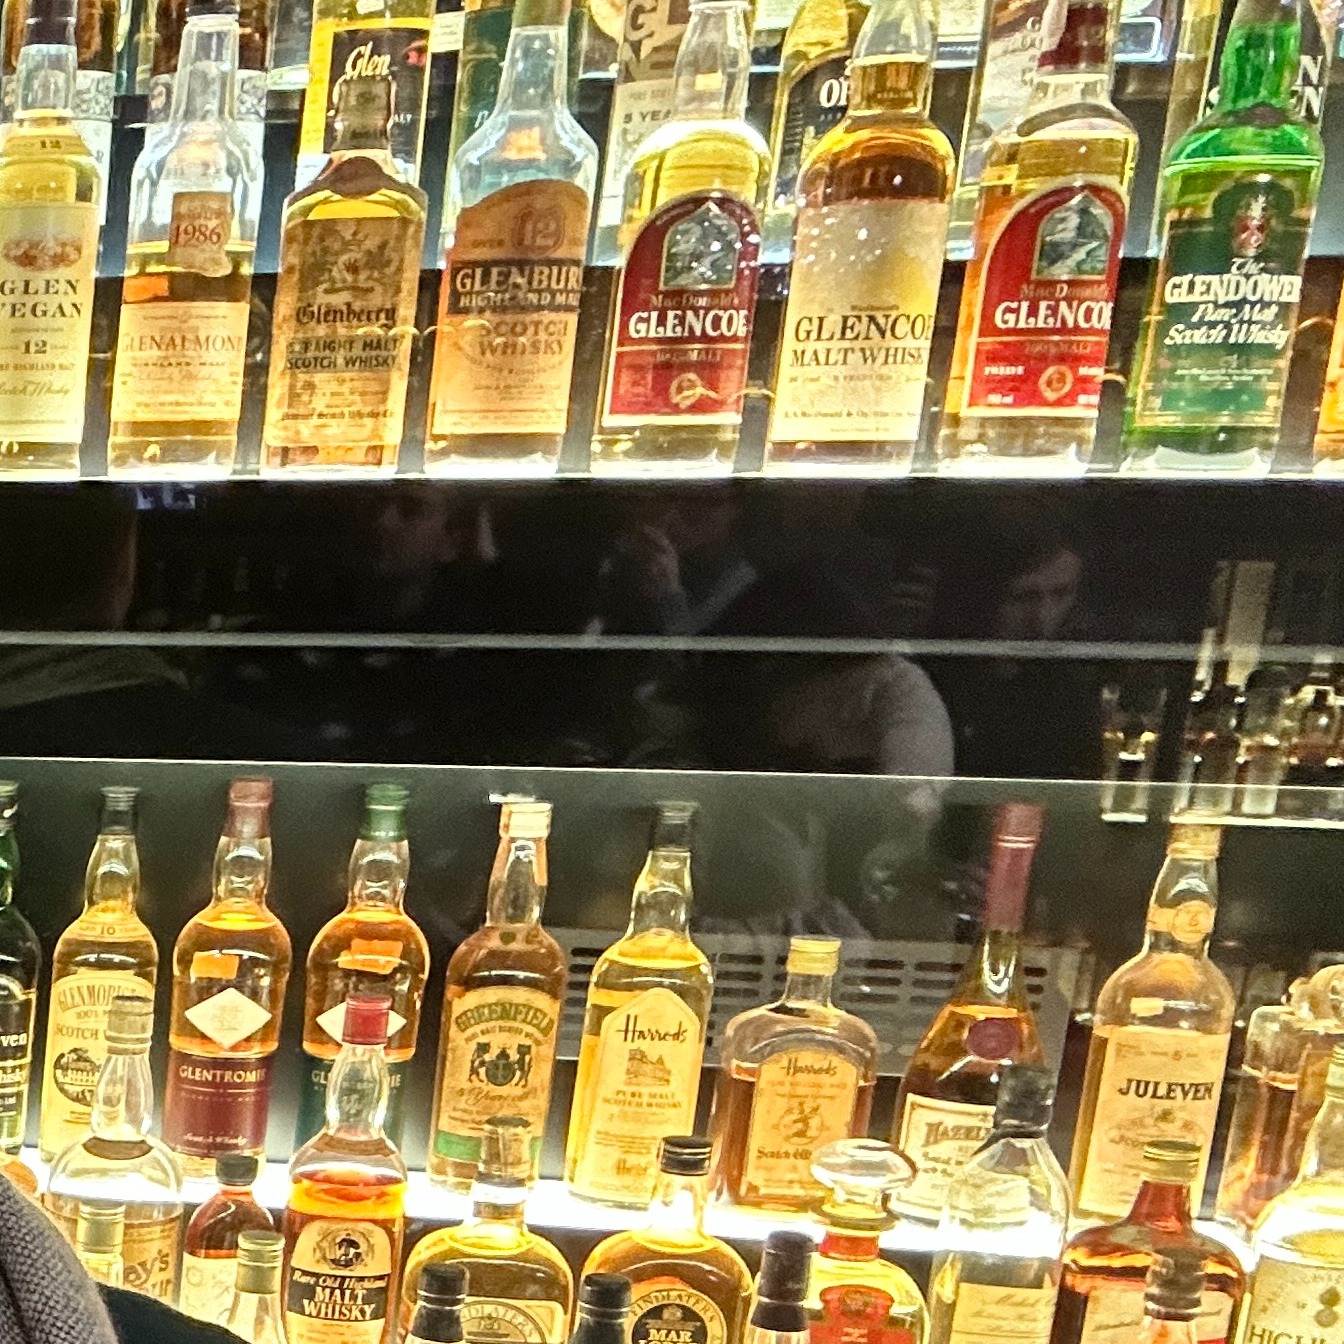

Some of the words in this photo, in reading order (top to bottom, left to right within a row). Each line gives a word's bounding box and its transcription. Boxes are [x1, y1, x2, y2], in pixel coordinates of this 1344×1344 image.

[344, 41, 391, 80] Glen
[175, 223, 223, 245] 1986
[1231, 257, 1265, 274] The
[0, 279, 81, 297] GLEN
[295, 301, 396, 329] Glenberry
[1191, 303, 1231, 324] Pure
[1234, 303, 1279, 323] Malt
[628, 309, 749, 338] GLENCOE
[362, 338, 399, 352] MALT
[1164, 322, 1228, 346] Scotch
[1230, 322, 1291, 350] Whisky
[20, 338, 48, 355] 12
[287, 355, 338, 370] SCOTCH
[343, 354, 396, 369] WHISKY
[789, 347, 855, 367] MALT
[99, 924, 116, 936] 10
[55, 1023, 100, 1040] SCOTCH
[616, 1013, 689, 1044] Harrods
[778, 1057, 839, 1077] Harrods
[318, 1275, 340, 1288] Old
[313, 1286, 369, 1304] MALT
[301, 1298, 377, 1321] WHISKY
[647, 1328, 693, 1343] MAR
